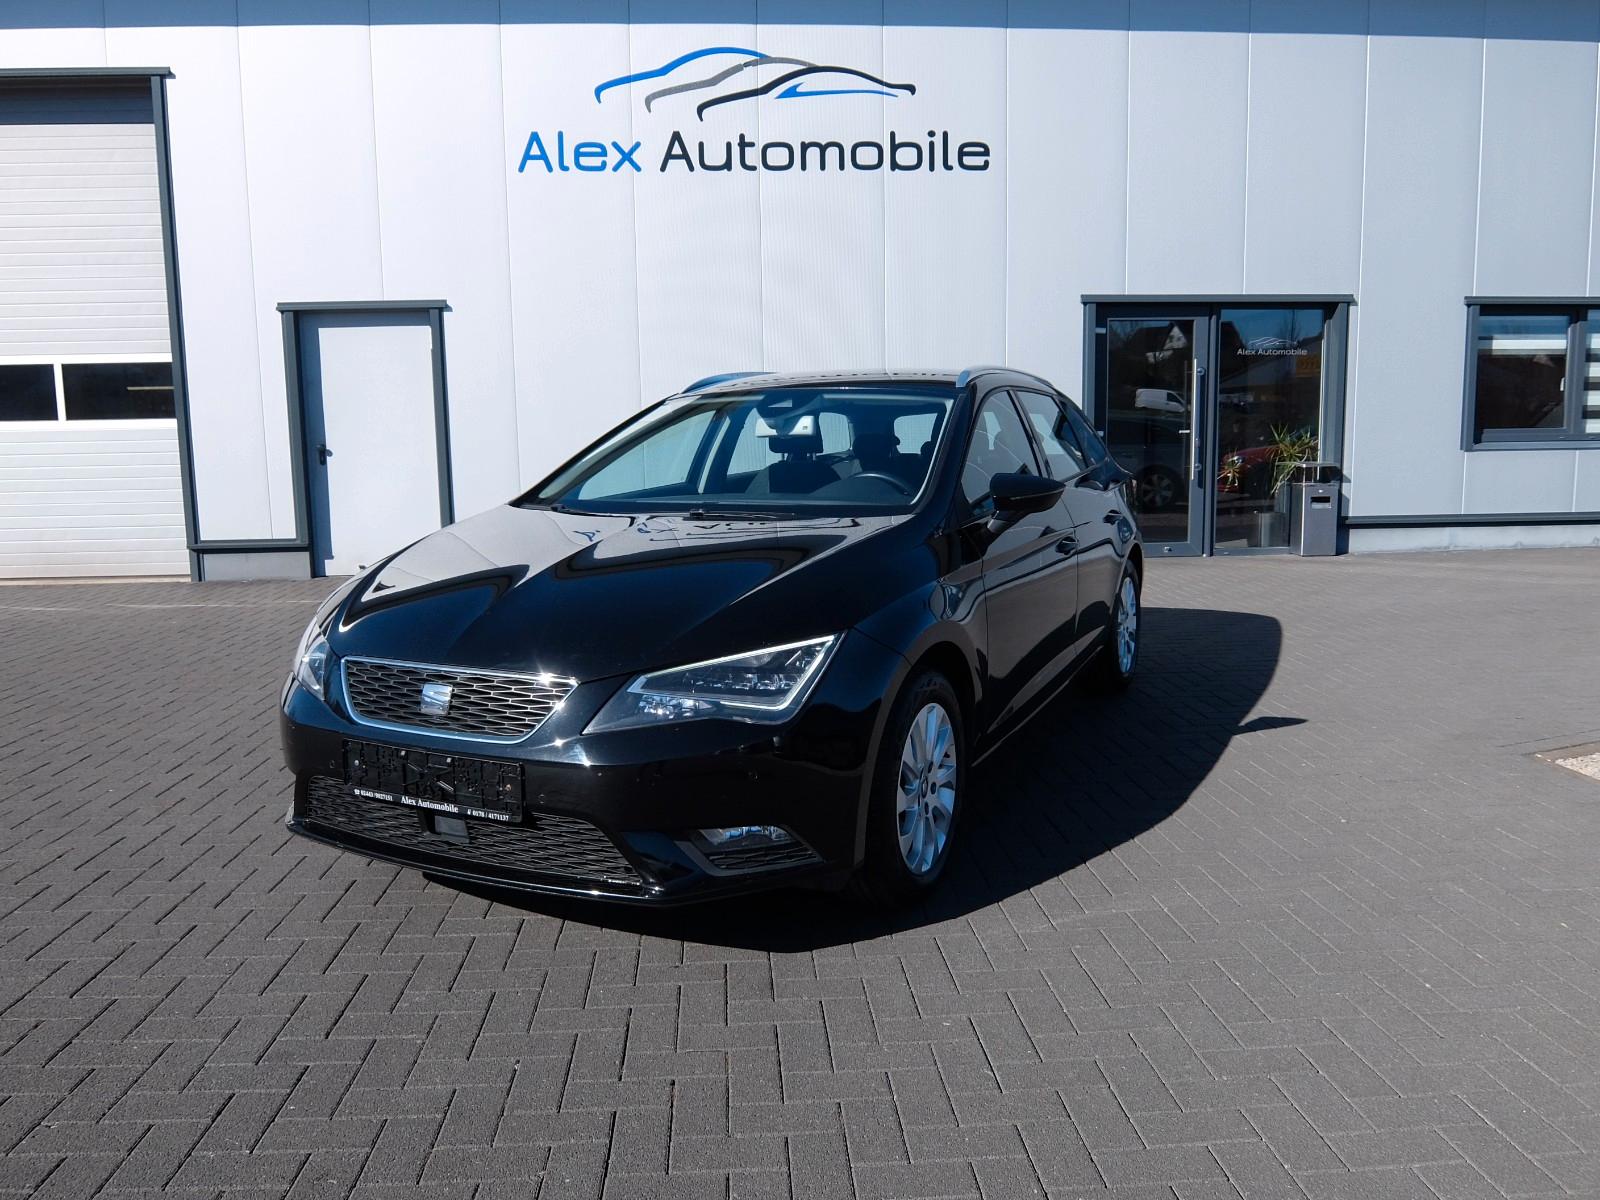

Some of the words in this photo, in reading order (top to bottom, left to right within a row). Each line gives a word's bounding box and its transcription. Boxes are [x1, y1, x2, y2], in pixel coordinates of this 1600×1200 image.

[518, 130, 642, 173] Alex
[659, 130, 991, 173] Automobile
[1237, 348, 1256, 356] Alex
[1257, 348, 1308, 356] Automobile
[401, 795, 416, 806] Alex
[417, 798, 459, 813] Automobile
